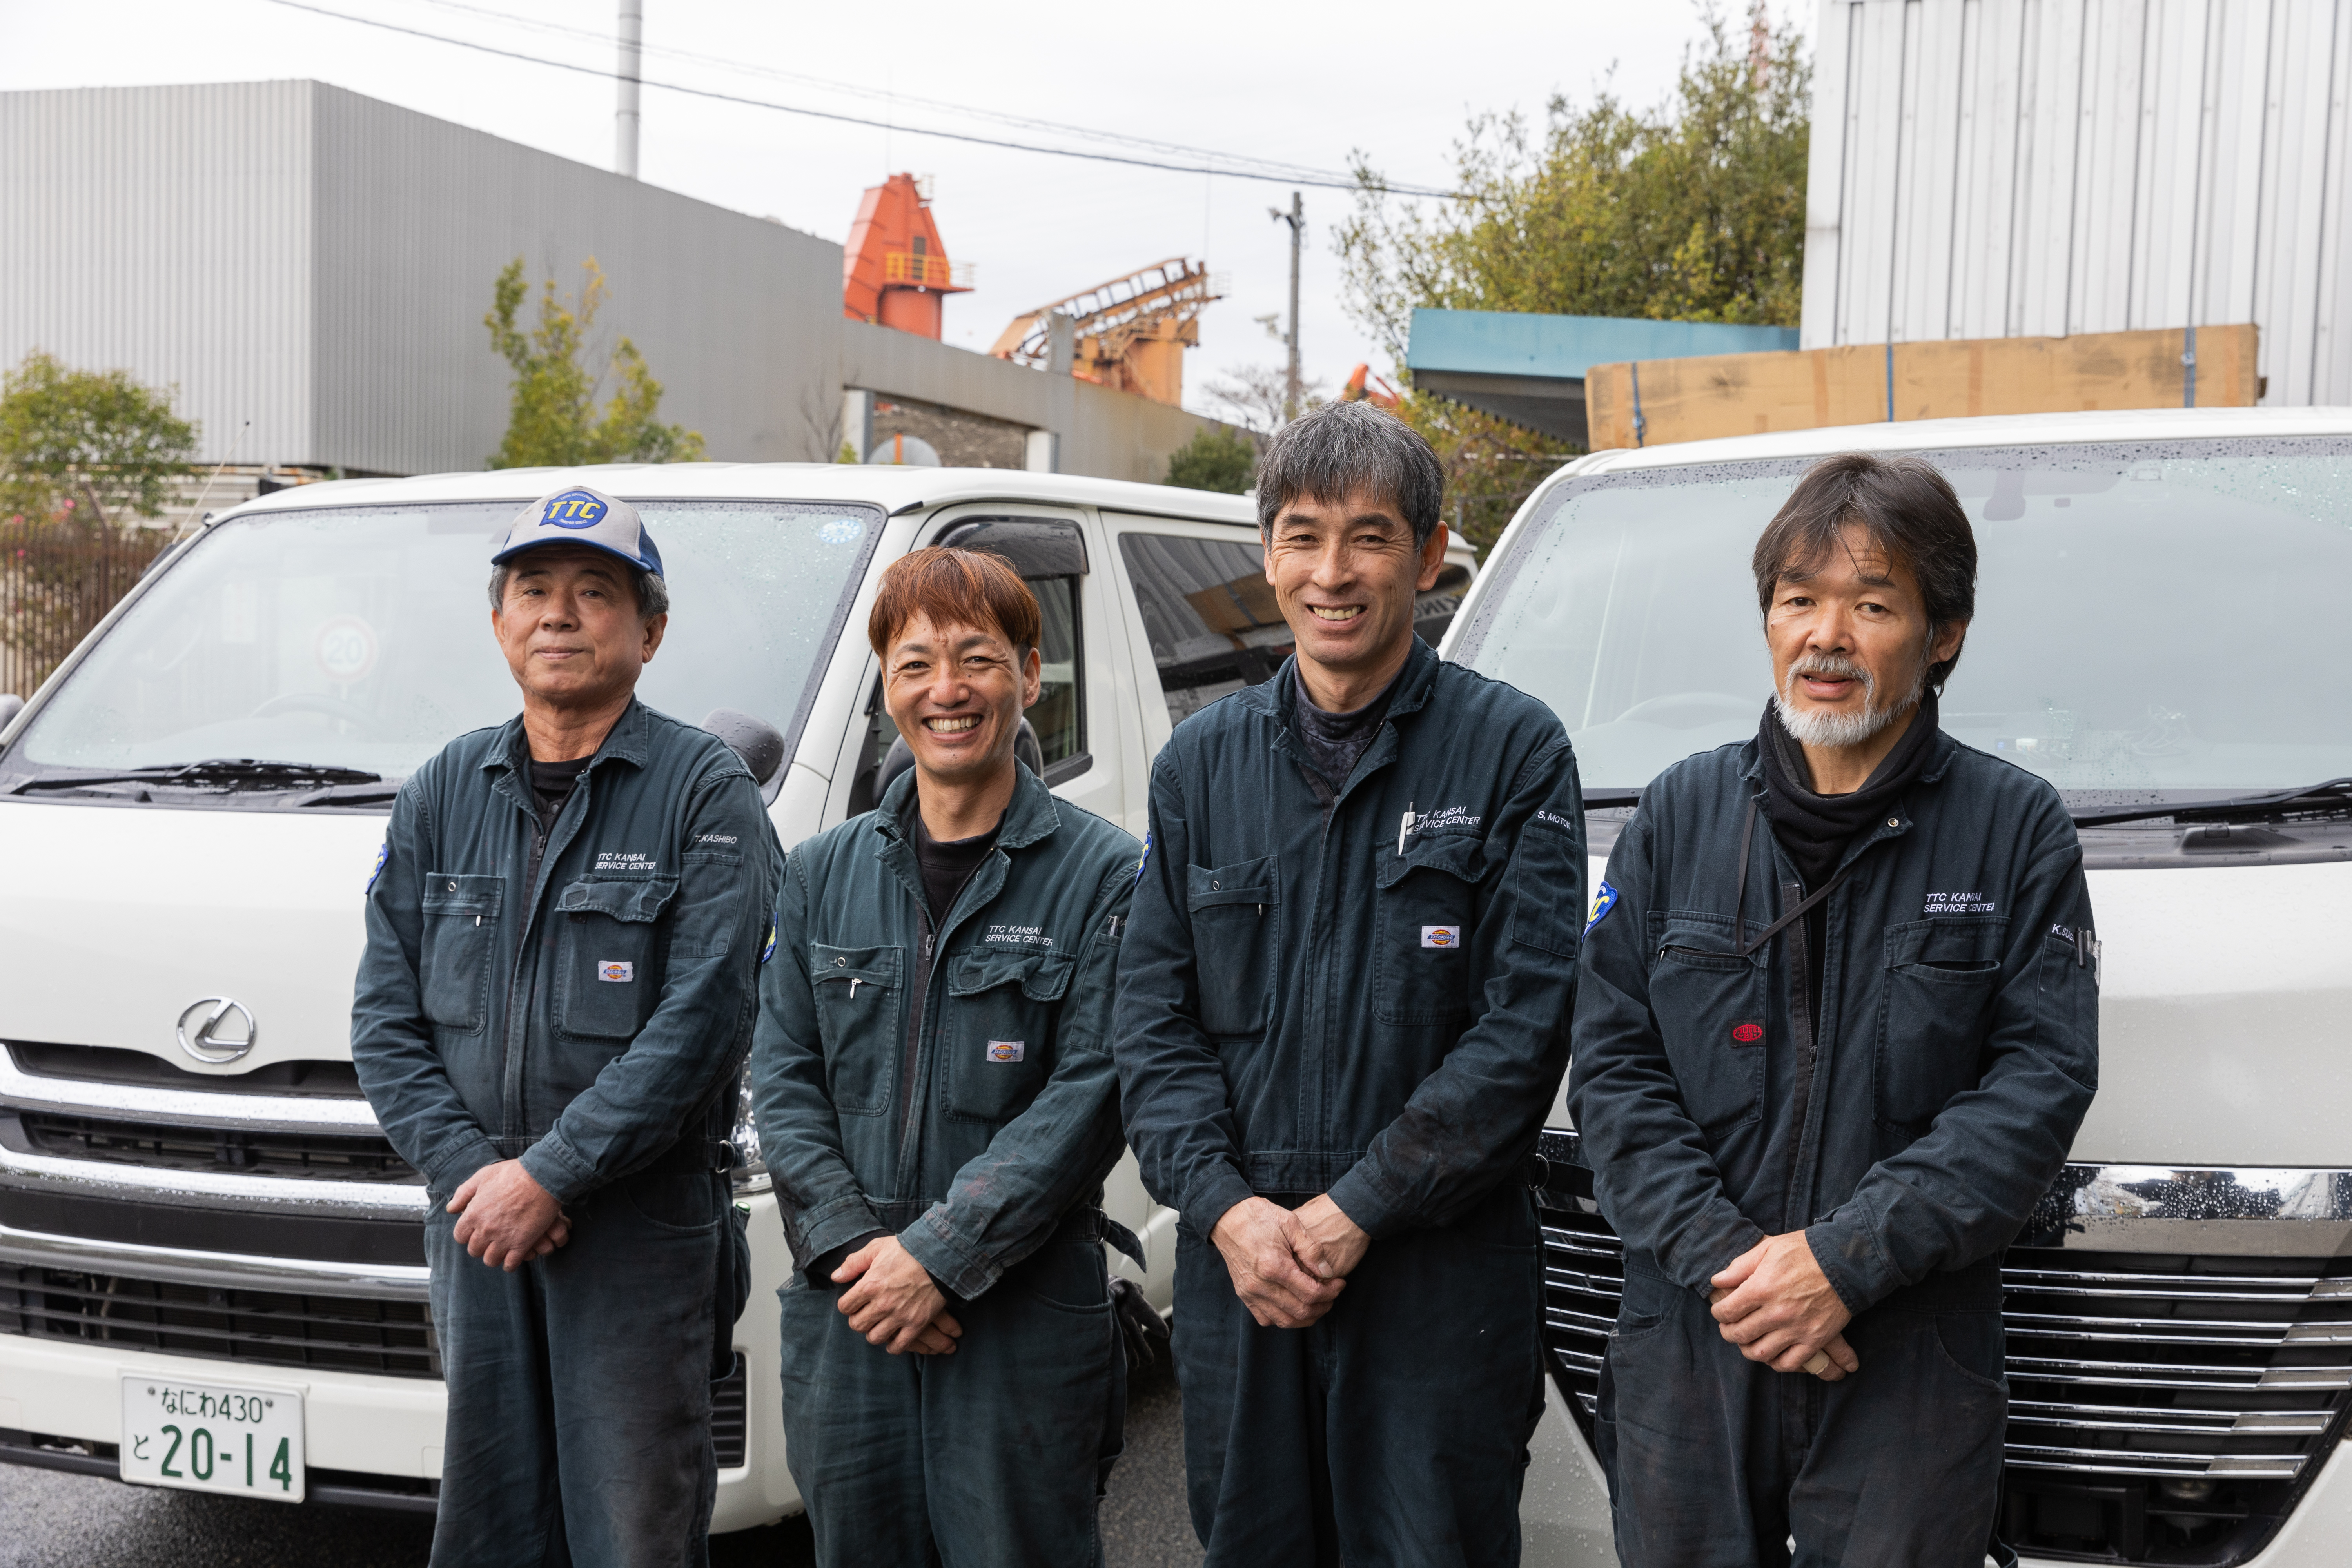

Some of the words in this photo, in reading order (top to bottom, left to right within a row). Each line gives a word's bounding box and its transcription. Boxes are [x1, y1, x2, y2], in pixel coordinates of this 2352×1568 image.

[548, 501, 601, 519] TTC
[327, 635, 363, 664] 20
[1433, 806, 1466, 818] KANSAI
[1446, 815, 1481, 825] CENTER
[695, 834, 737, 844] T.KASHIBO
[598, 853, 612, 861] TTC
[614, 853, 646, 862] KANSAI
[1927, 893, 1947, 902] TTC
[1951, 892, 1982, 902] KANSAI
[1924, 903, 1967, 912] SERVICE
[1008, 925, 1042, 935] KANSAI
[985, 934, 1021, 942] SERVICE
[133, 1433, 149, 1460] と
[161, 1425, 292, 1491] 20-14
